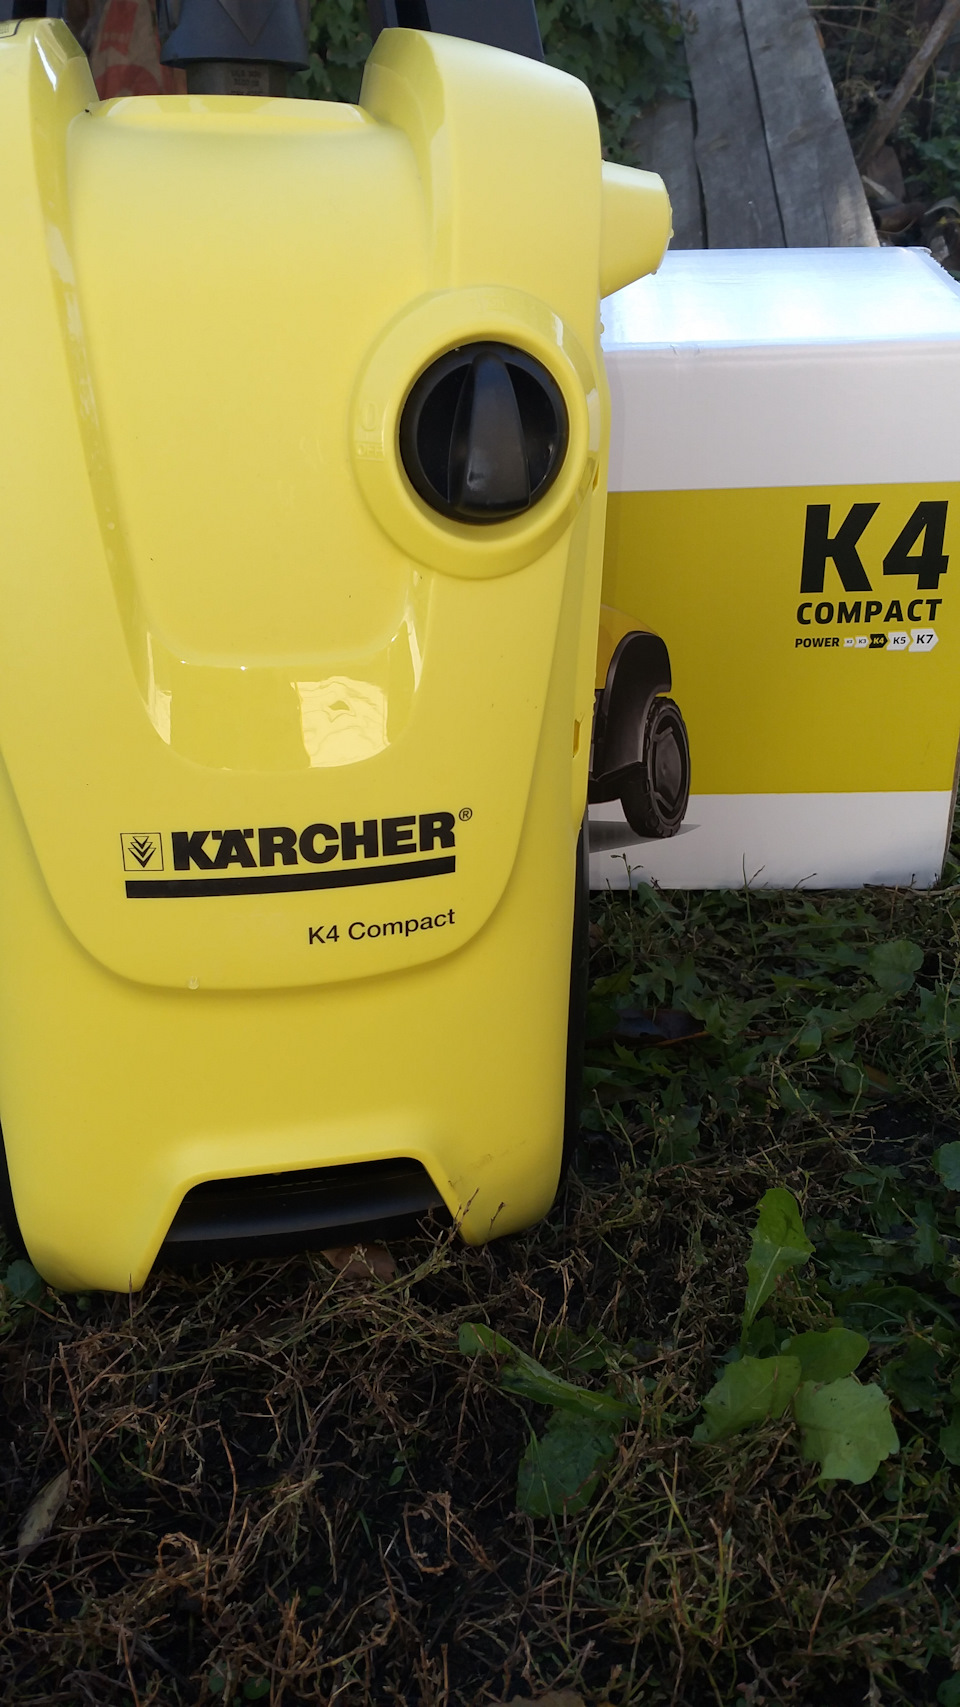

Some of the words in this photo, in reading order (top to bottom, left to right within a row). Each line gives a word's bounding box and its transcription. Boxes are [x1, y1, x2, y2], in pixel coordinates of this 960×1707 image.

[796, 599, 943, 625] COMPACT
[795, 637, 840, 648] POWER
[873, 637, 884, 645] K4
[893, 636, 906, 645] K5
[916, 634, 933, 644] K7
[308, 925, 340, 945] K4
[348, 908, 456, 941] Compact
